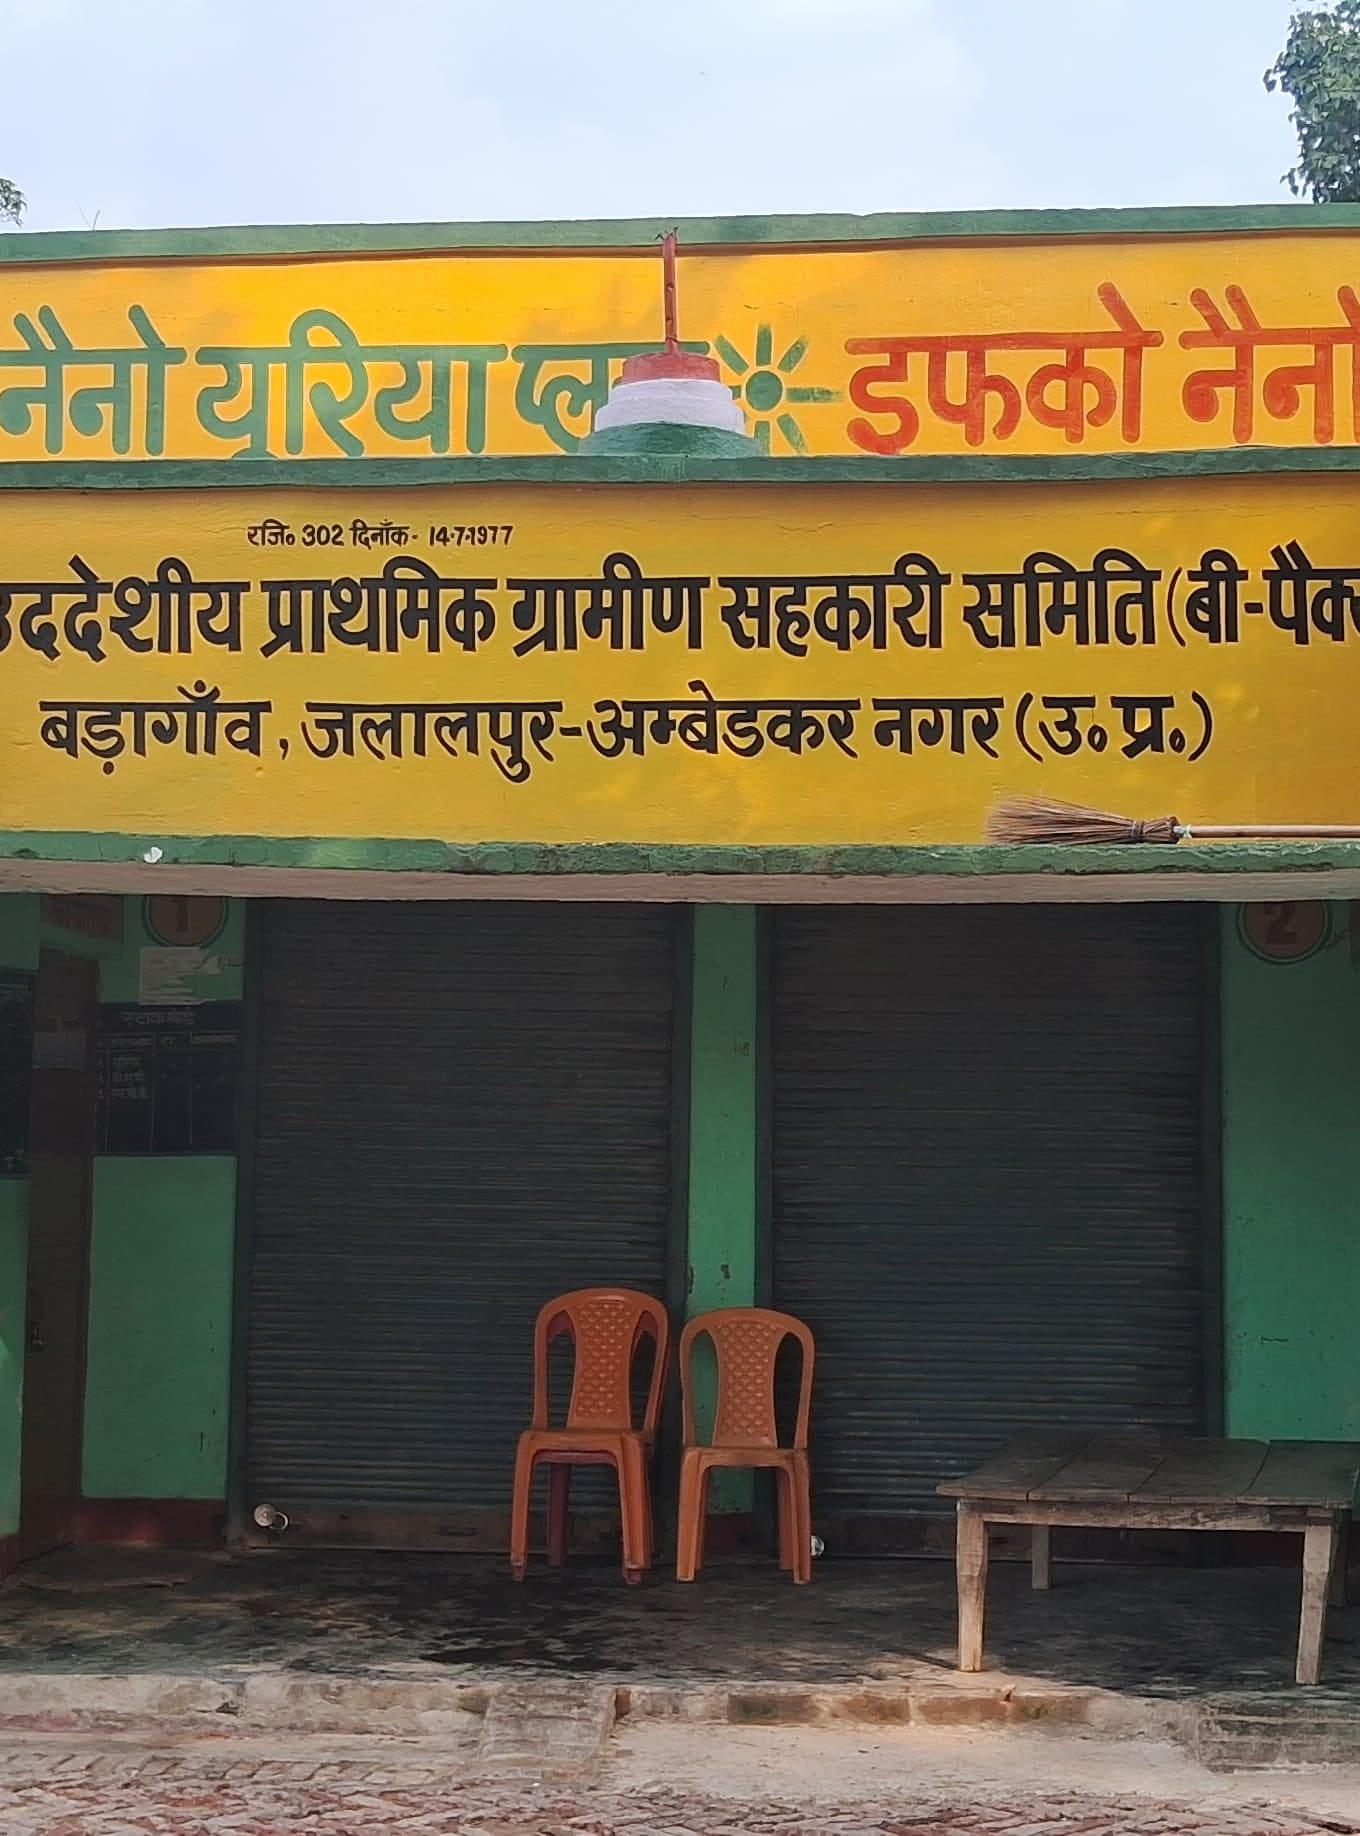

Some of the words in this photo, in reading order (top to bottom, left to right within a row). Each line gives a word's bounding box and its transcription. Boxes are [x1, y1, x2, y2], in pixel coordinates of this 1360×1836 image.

[300, 523, 346, 547] 302
[259, 555, 498, 657] प्राथमिक
[506, 552, 711, 657] ग्रामीण
[719, 550, 952, 658] सहकारी
[871, 695, 1006, 761] नगर
